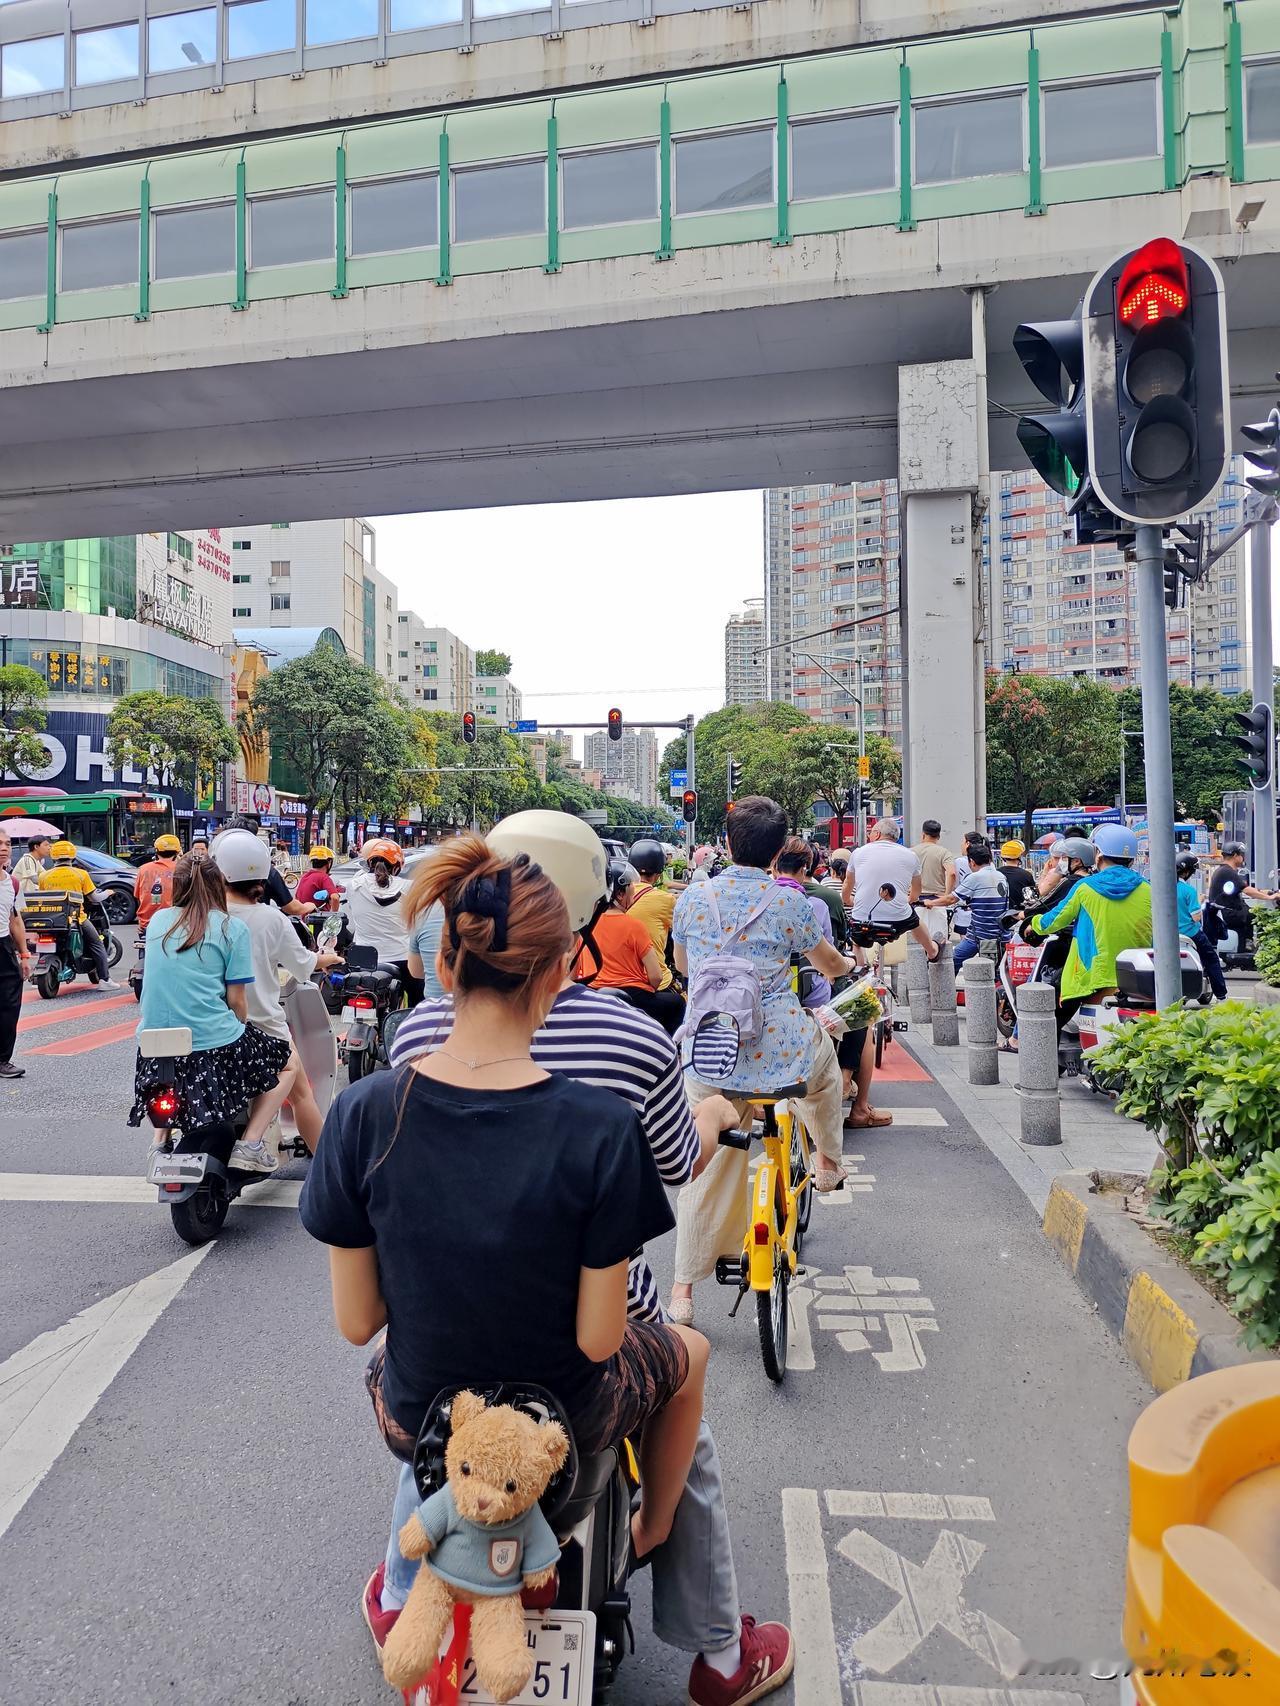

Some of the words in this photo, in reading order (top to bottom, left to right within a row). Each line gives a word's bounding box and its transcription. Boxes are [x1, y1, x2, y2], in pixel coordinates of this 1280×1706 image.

[0, 560, 38, 593] 店
[154, 600, 213, 642] LAVANDE
[0, 732, 180, 787] OHLE
